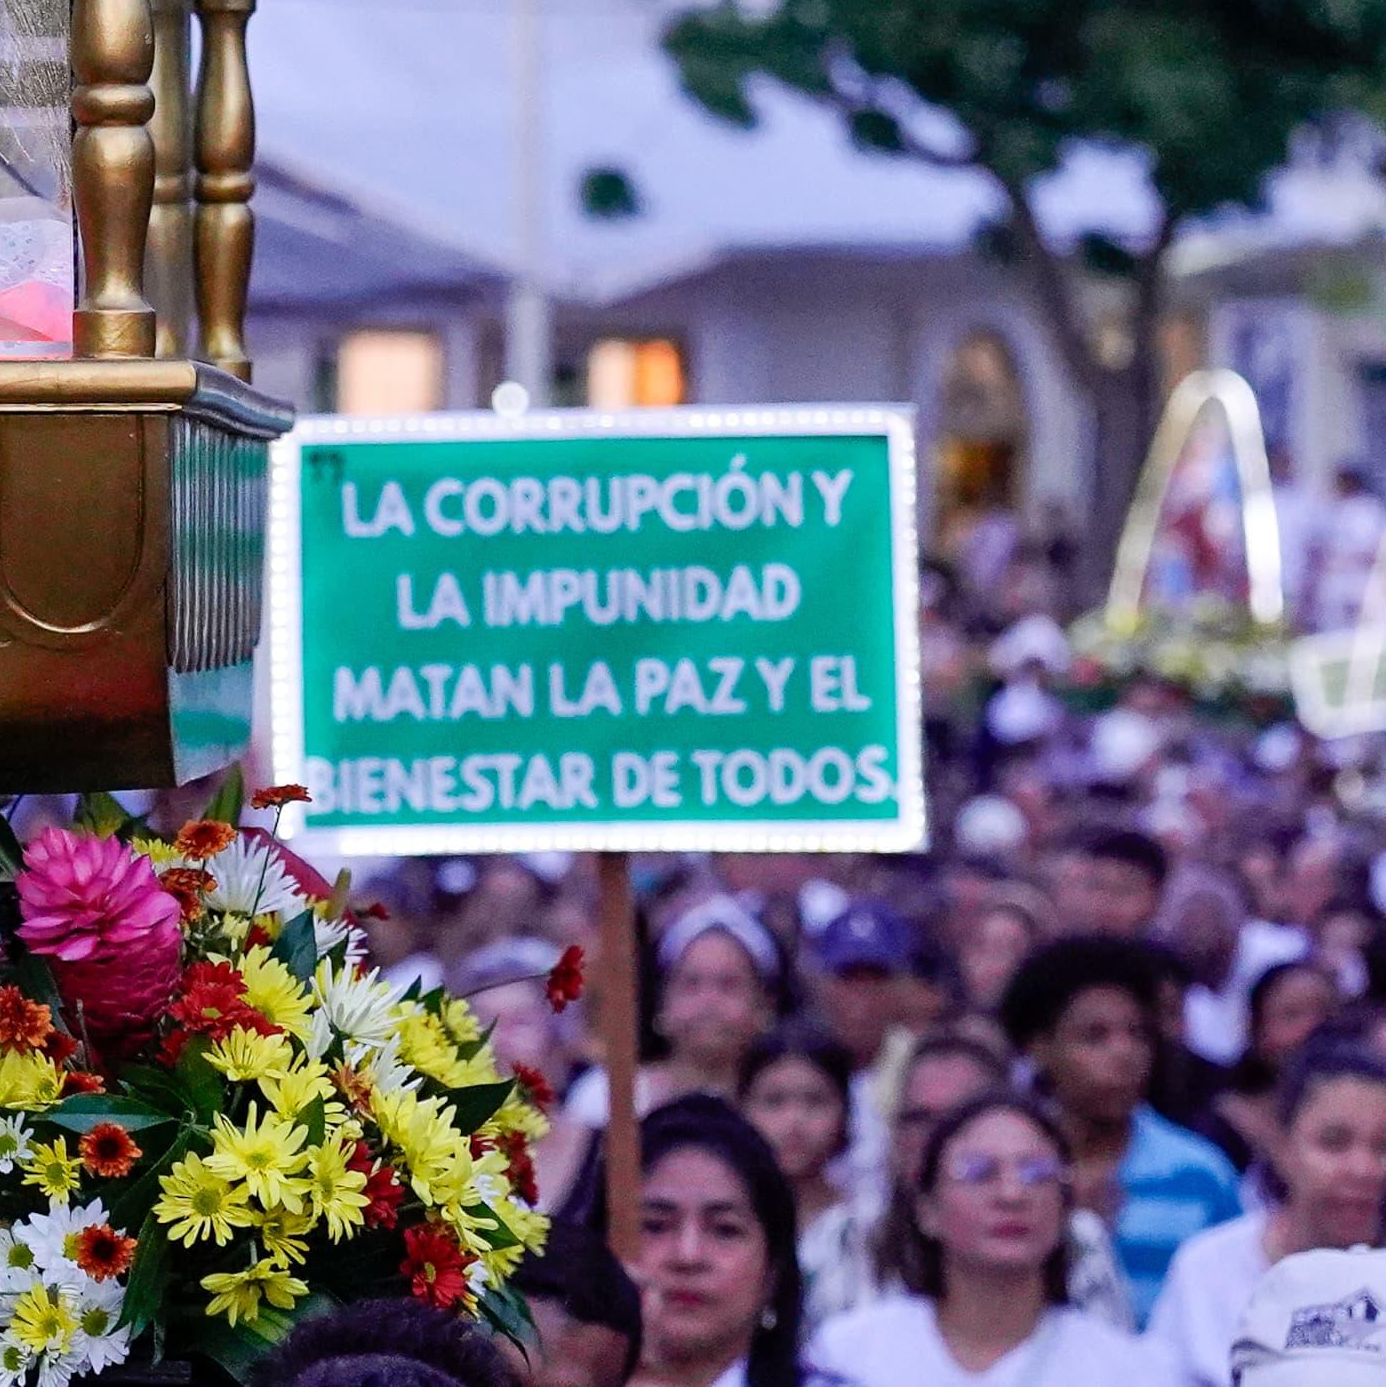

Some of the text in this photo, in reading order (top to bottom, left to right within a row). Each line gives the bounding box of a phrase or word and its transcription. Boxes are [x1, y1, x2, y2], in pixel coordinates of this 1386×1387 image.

[341, 454, 853, 537] LA CORRUPCIÓN Y
[396, 563, 801, 628] LA IMPUNIDAD
[334, 656, 871, 722] MATAN LA PAZ Y EL
[306, 752, 595, 814] BIENESTAR
[612, 751, 684, 807] DE
